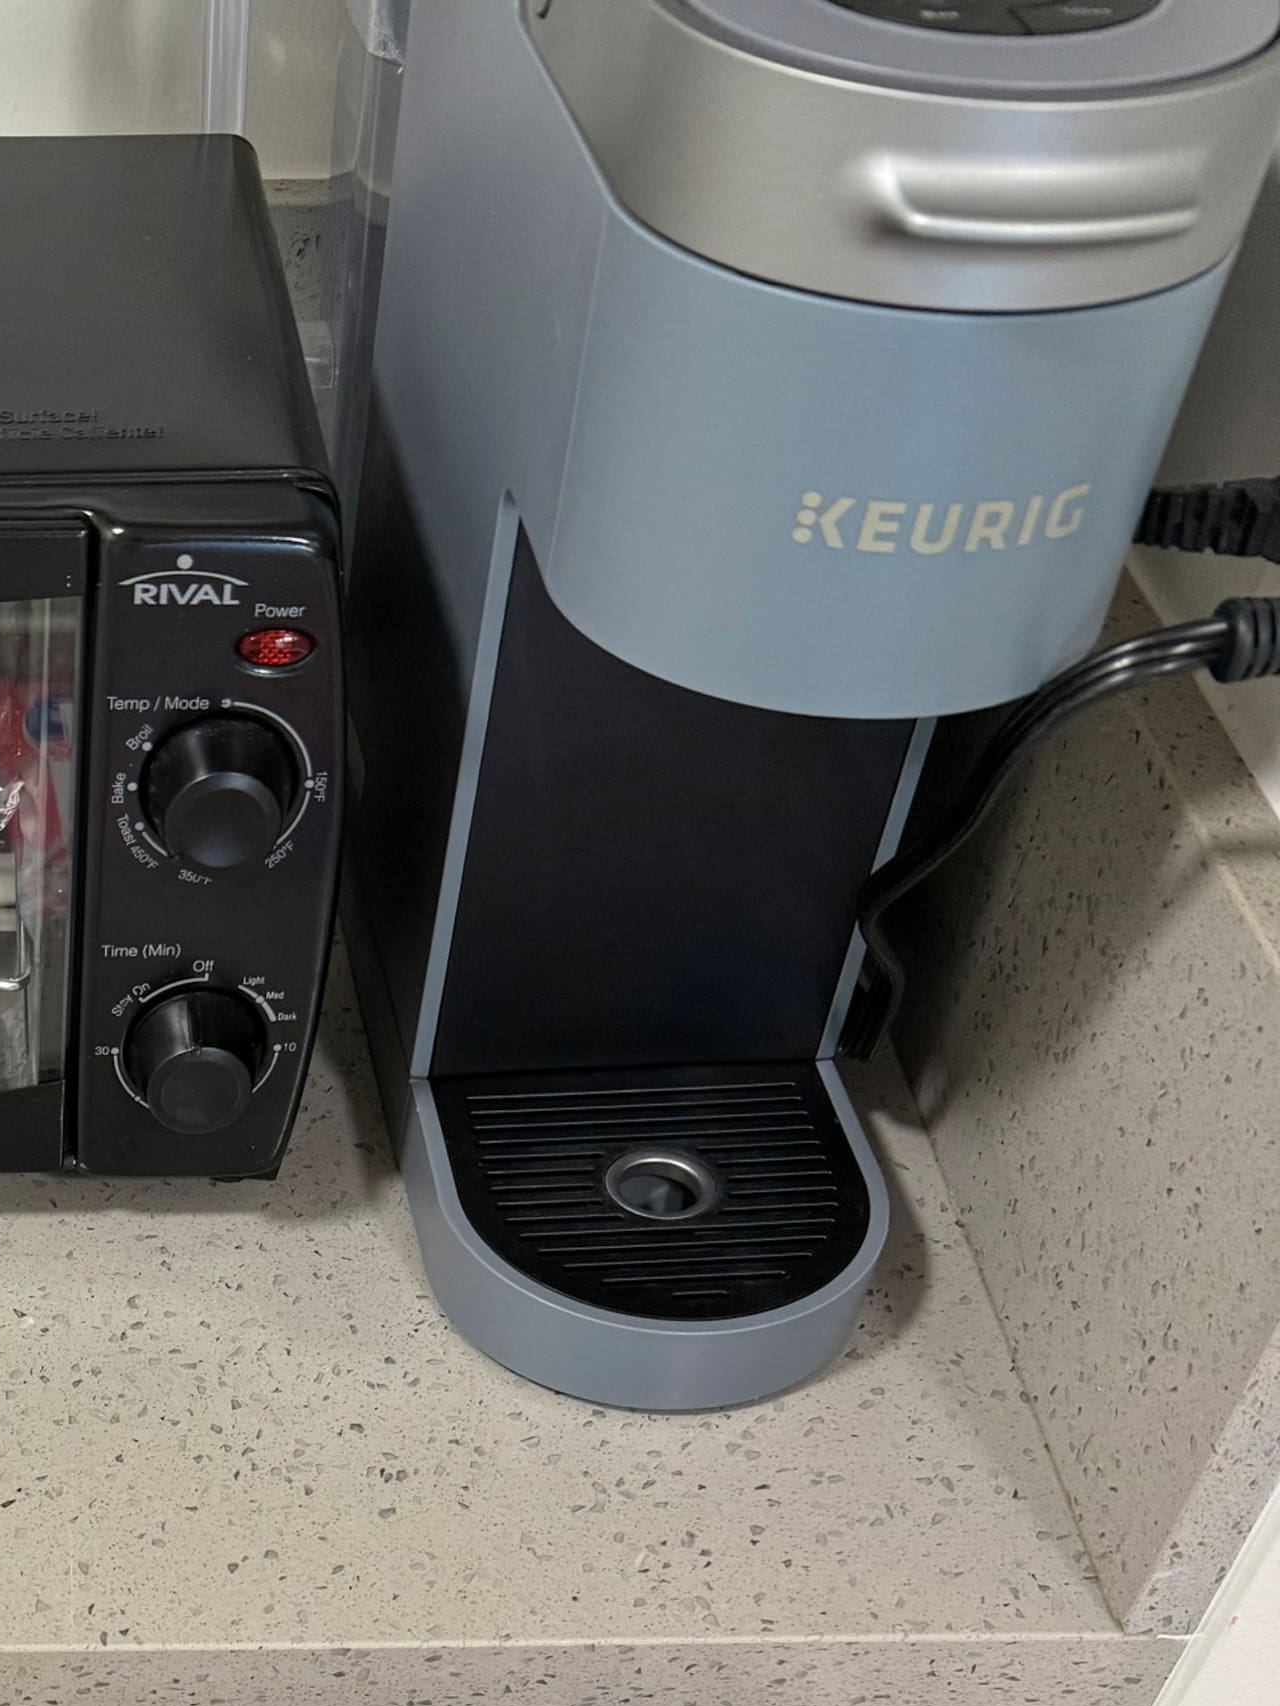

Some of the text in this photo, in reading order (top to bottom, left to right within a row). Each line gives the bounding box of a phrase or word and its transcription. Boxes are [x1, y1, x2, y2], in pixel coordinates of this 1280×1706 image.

[792, 484, 1091, 556] KEURIG
[134, 583, 240, 606] RIVAL
[254, 602, 306, 620] Power
[107, 696, 150, 712] Temp
[164, 696, 210, 710] Mode
[125, 724, 153, 750] Broil
[112, 773, 126, 804] Bake
[117, 813, 136, 847] Toast
[101, 943, 181, 958] Time (Min)
[192, 960, 214, 972] Off
[243, 976, 265, 985] Light
[133, 982, 150, 997] On
[278, 1013, 296, 1021] Dark
[95, 1046, 109, 1056] 30
[283, 1043, 296, 1051] 10
